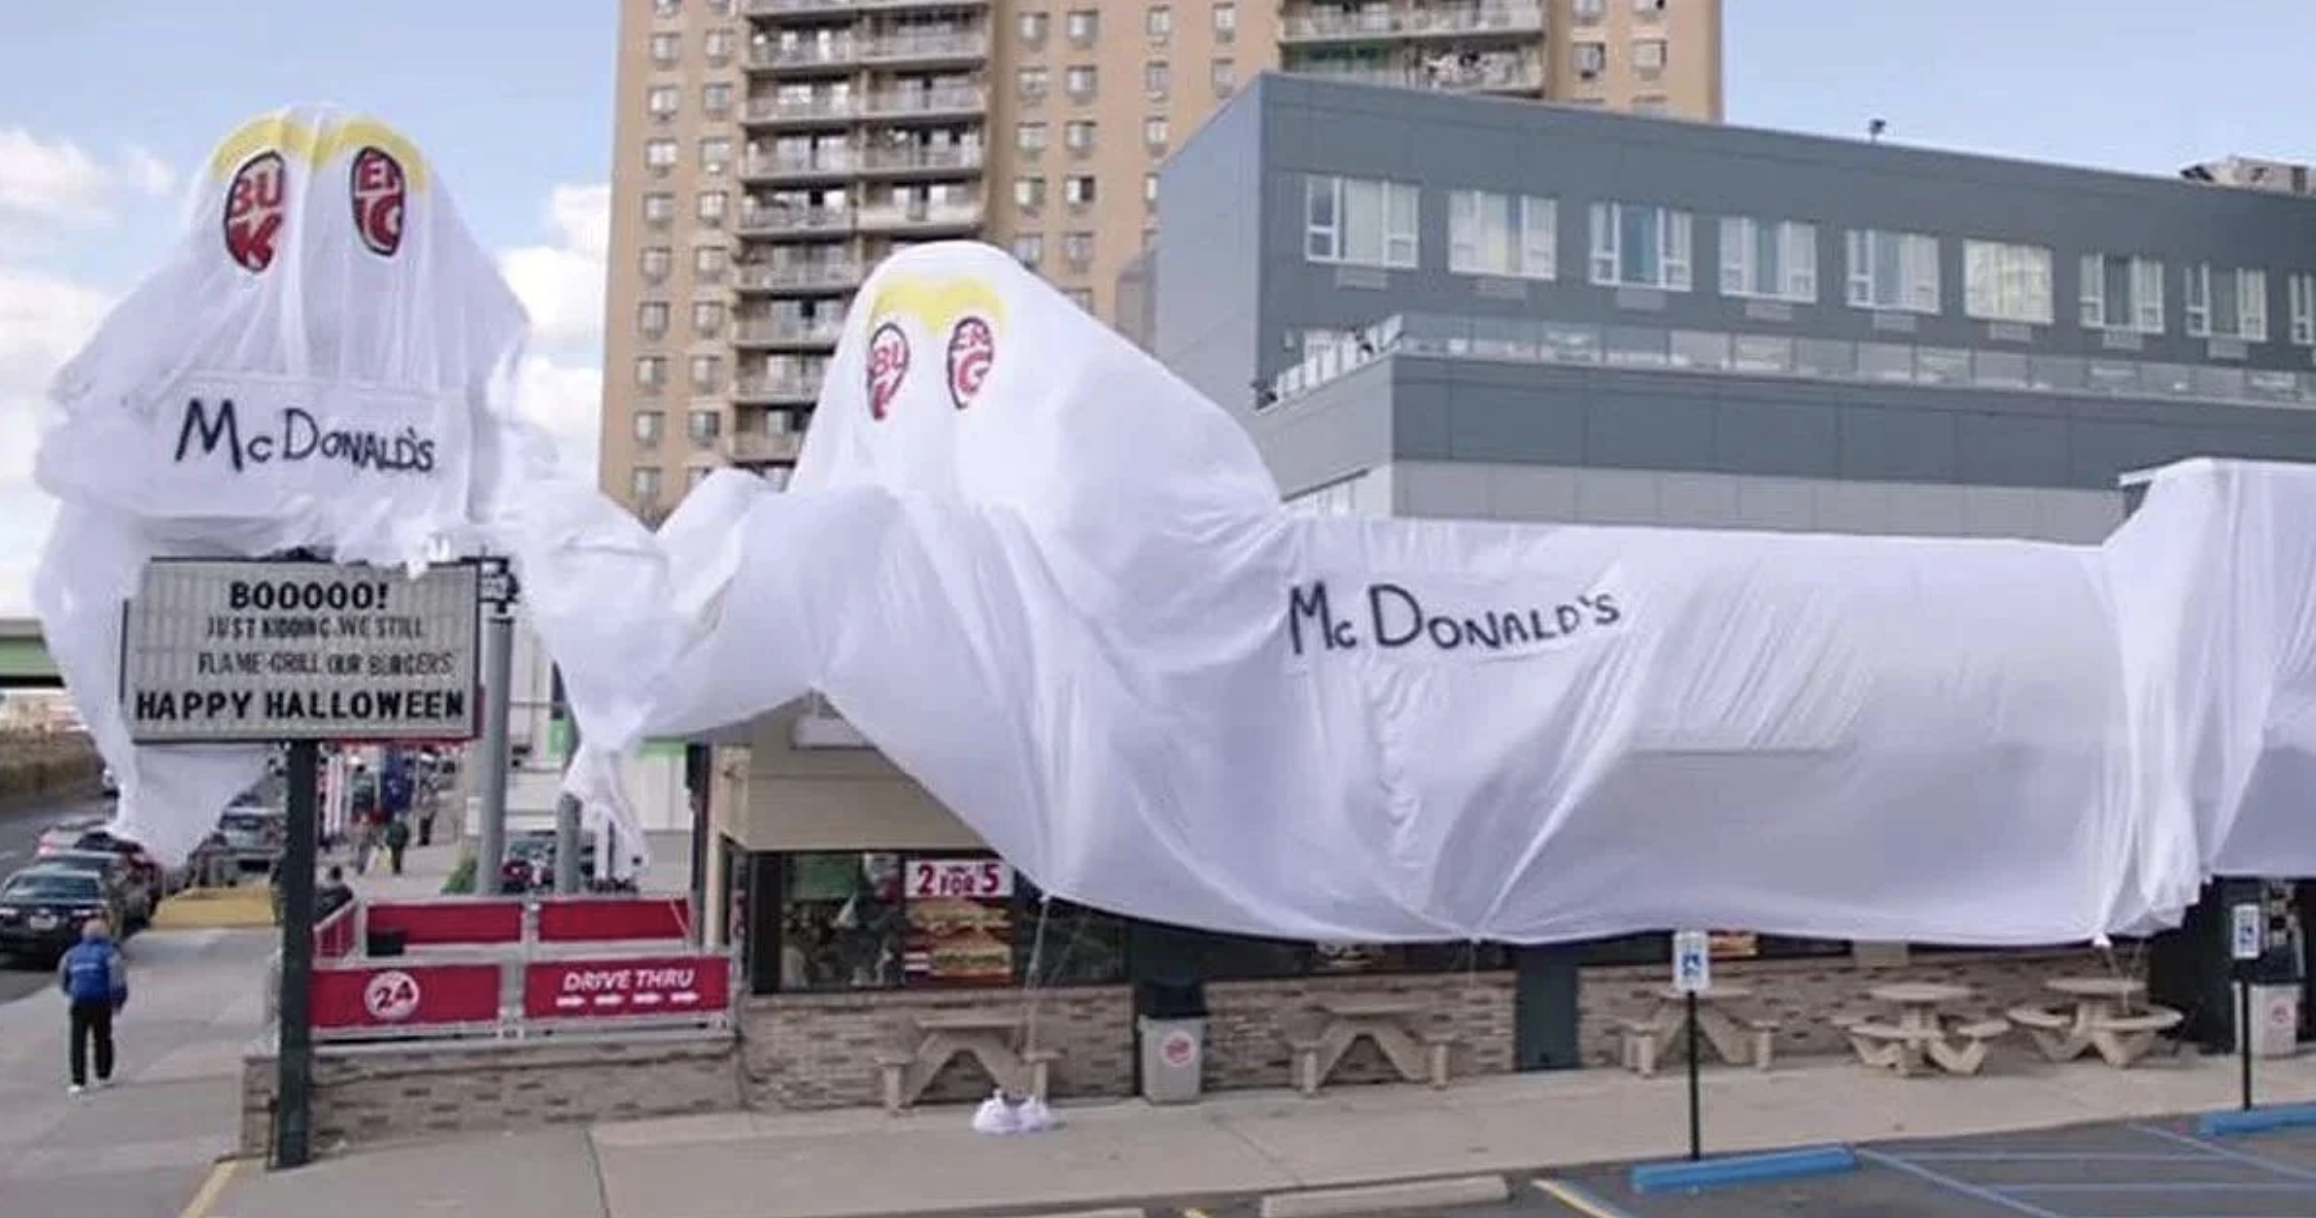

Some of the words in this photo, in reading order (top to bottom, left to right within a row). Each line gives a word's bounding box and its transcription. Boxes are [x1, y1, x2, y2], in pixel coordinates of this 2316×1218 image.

[206, 615, 256, 641] JUST
[338, 615, 368, 639] WE
[376, 616, 424, 640] STILL
[327, 652, 363, 676] OUR
[368, 651, 455, 677] BURGERS
[135, 689, 253, 720] HAPPY
[264, 689, 466, 719] HALLOWEEN
[918, 864, 934, 895] 2
[562, 970, 631, 992] DRIVE
[636, 968, 695, 988] THRU
[373, 979, 414, 1011] 24
